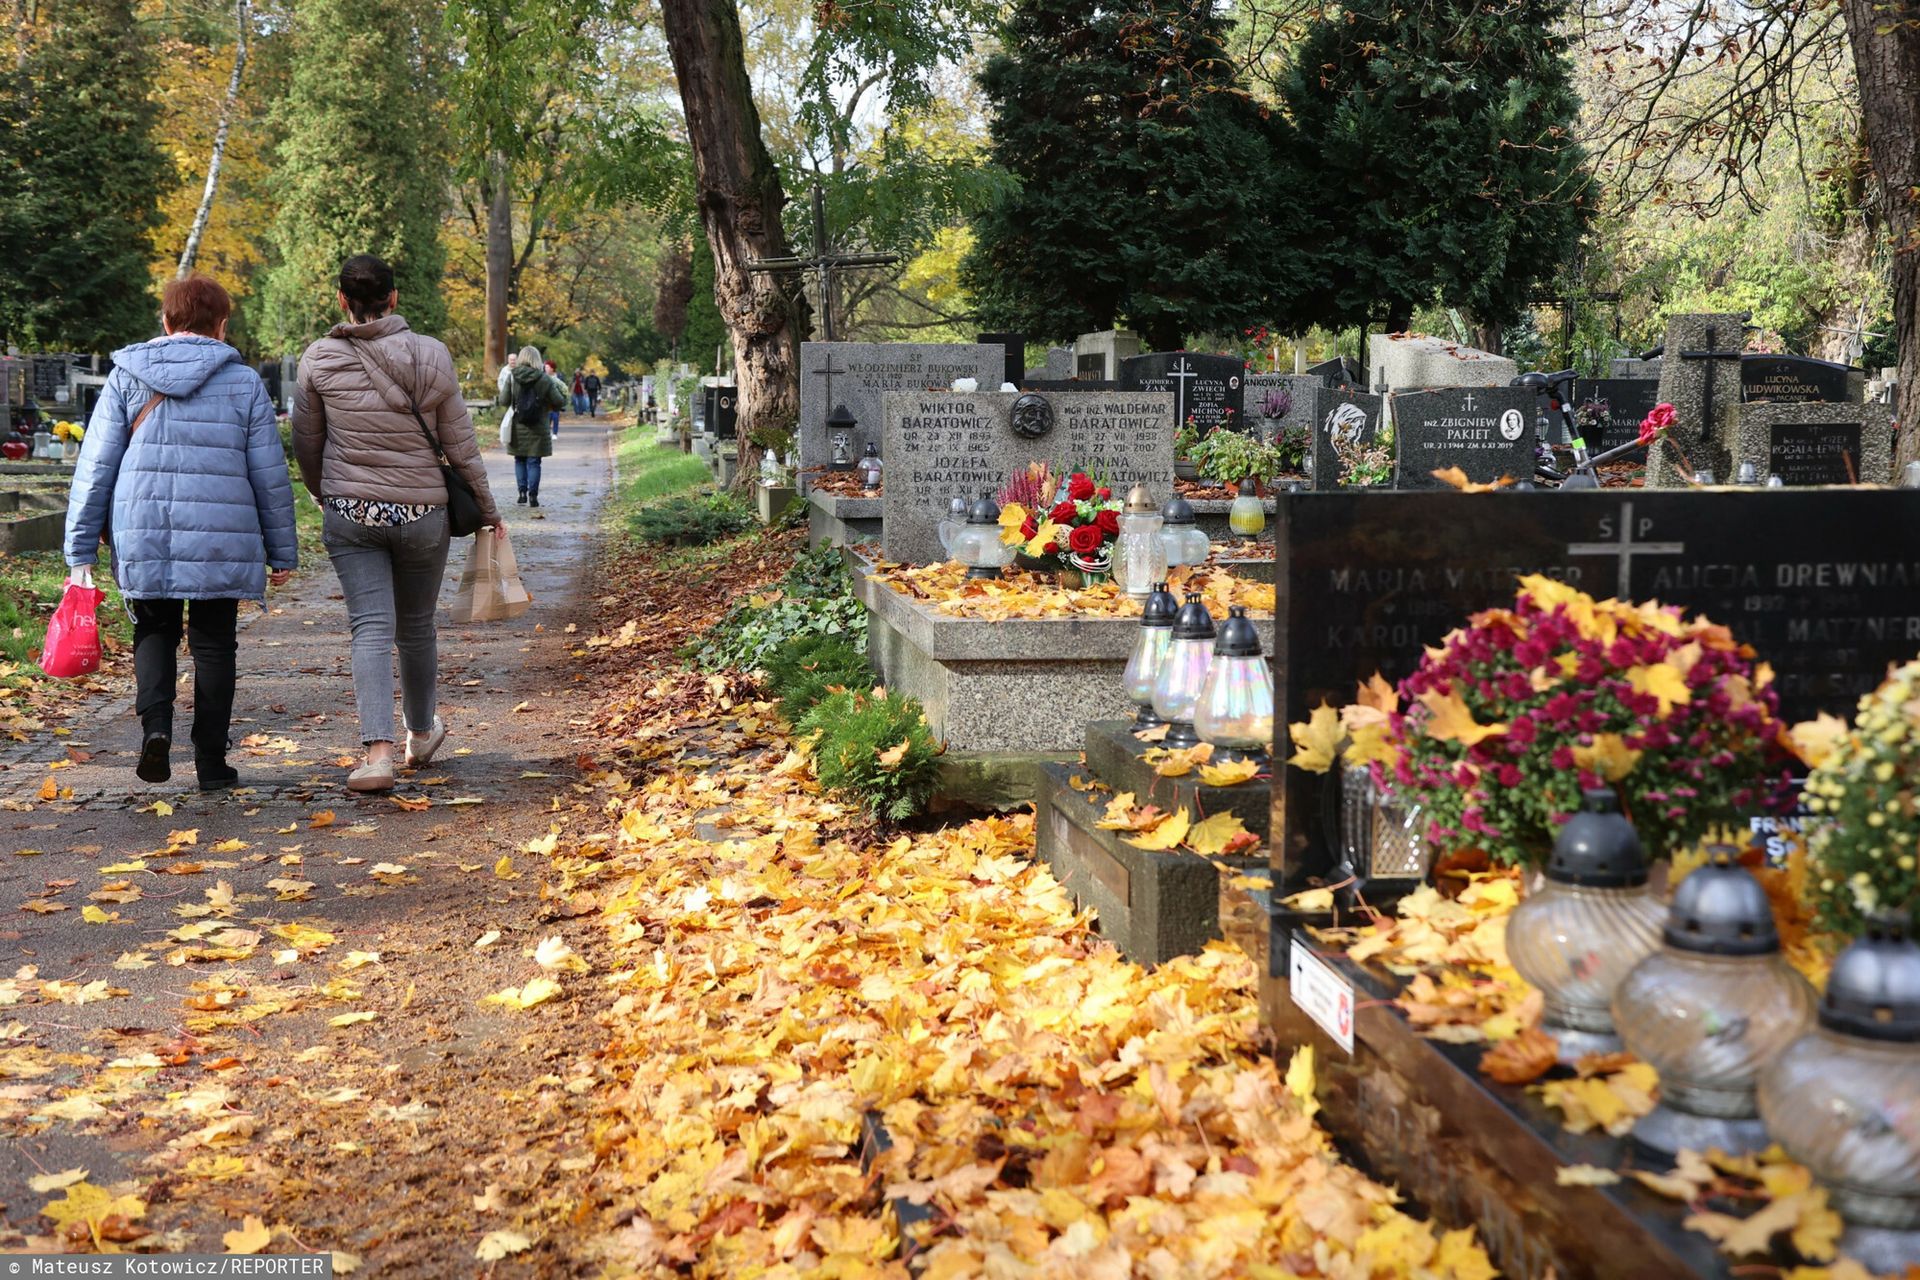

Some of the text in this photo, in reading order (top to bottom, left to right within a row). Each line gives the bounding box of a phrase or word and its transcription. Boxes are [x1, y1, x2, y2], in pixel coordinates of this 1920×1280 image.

[927, 364, 978, 373] BUKOWSKI
[862, 379, 952, 389] MARIA BUKOWS
[1244, 378, 1294, 387] ANKOWSCY
[1765, 375, 1799, 384] LUCYNA
[1743, 384, 1820, 394] LUDWIKOWSKA
[920, 402, 976, 415] WIKTOR
[1064, 406, 1081, 414] MGR
[1104, 403, 1166, 415] WALDEMAR
[902, 417, 993, 429] BARATOWICZ
[1069, 417, 1160, 429] BARATOWICZ
[1440, 417, 1497, 427] ZBIGNIEW
[1095, 432, 1106, 441] 27
[1114, 432, 1126, 441] VII
[1447, 429, 1491, 440] PAKIET
[1093, 443, 1105, 453] 27
[1113, 443, 1125, 453] VII
[1134, 443, 1157, 453] 2007
[913, 471, 1004, 483] BARATOWICZ
[1639, 518, 1653, 537] P
[1329, 567, 1427, 593] MARIA
[1787, 617, 1920, 642] MATZNER
